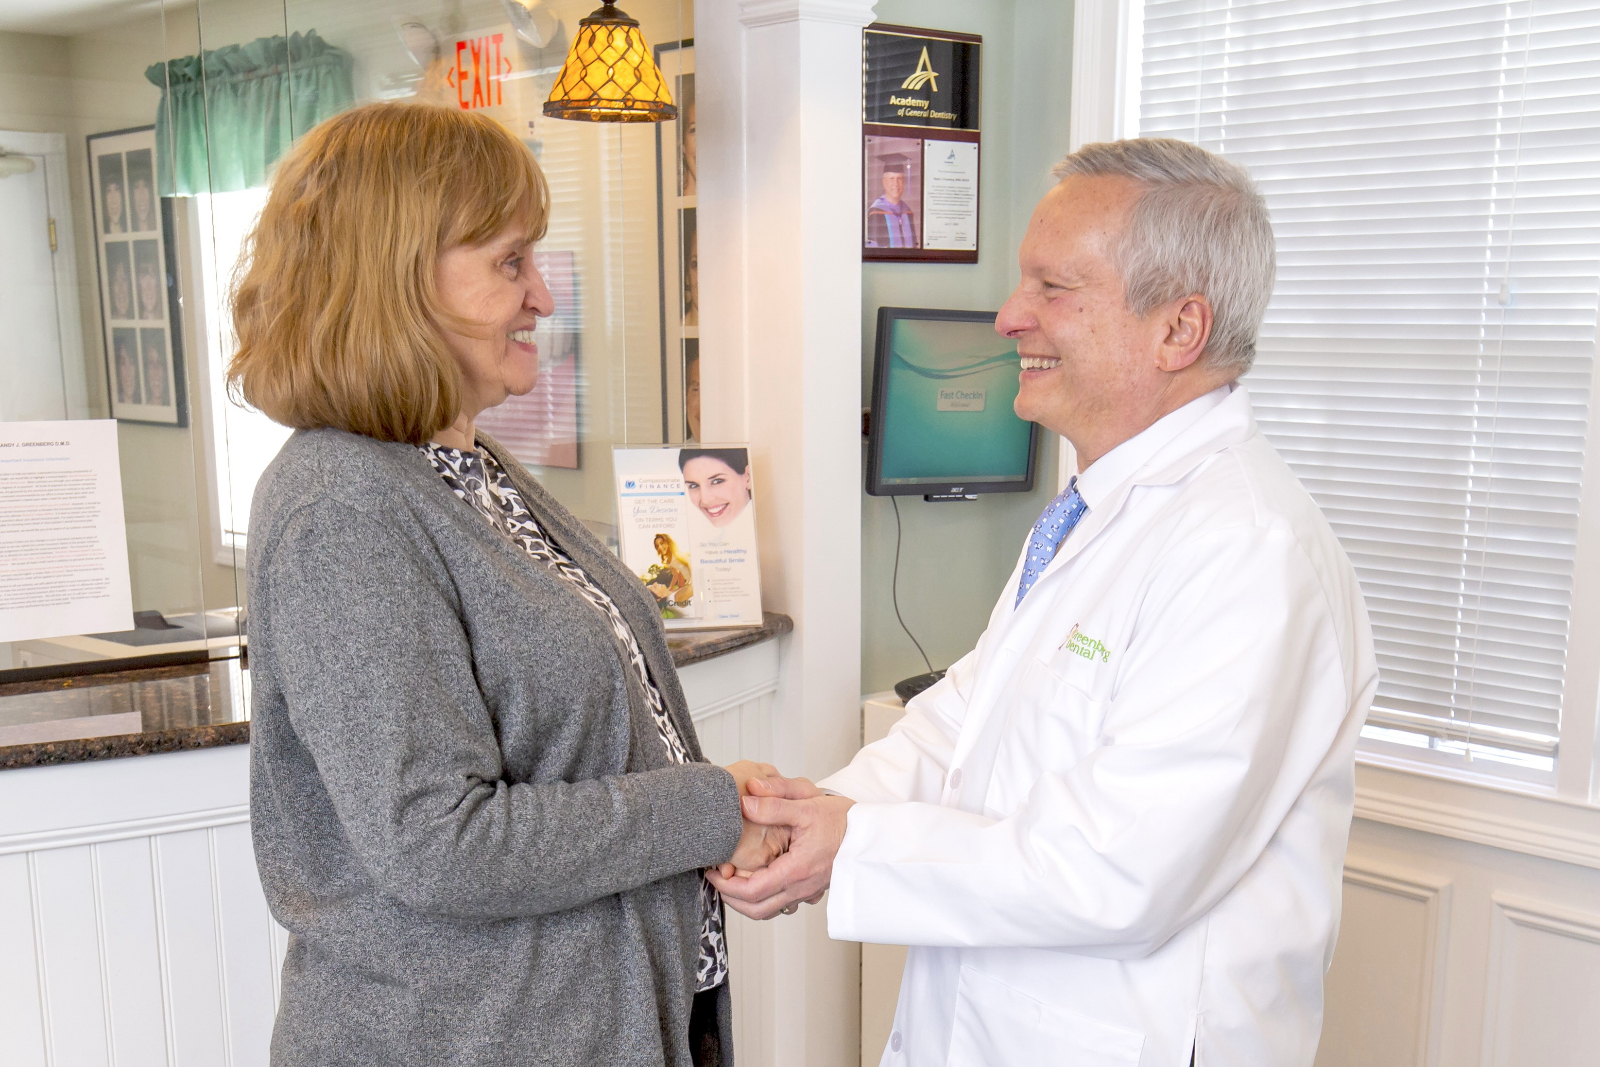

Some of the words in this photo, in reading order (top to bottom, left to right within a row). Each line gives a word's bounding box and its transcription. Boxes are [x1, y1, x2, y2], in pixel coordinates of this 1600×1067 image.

[456, 33, 504, 110] EXIT
[889, 95, 930, 110] Academy
[897, 107, 905, 117] of
[905, 108, 929, 118] General
[929, 110, 958, 121] Dentistry
[940, 390, 954, 399] Fast
[633, 506, 647, 517] You
[649, 506, 679, 514] Deserve
[668, 599, 692, 607] Credit
[1065, 639, 1096, 660] Dental
